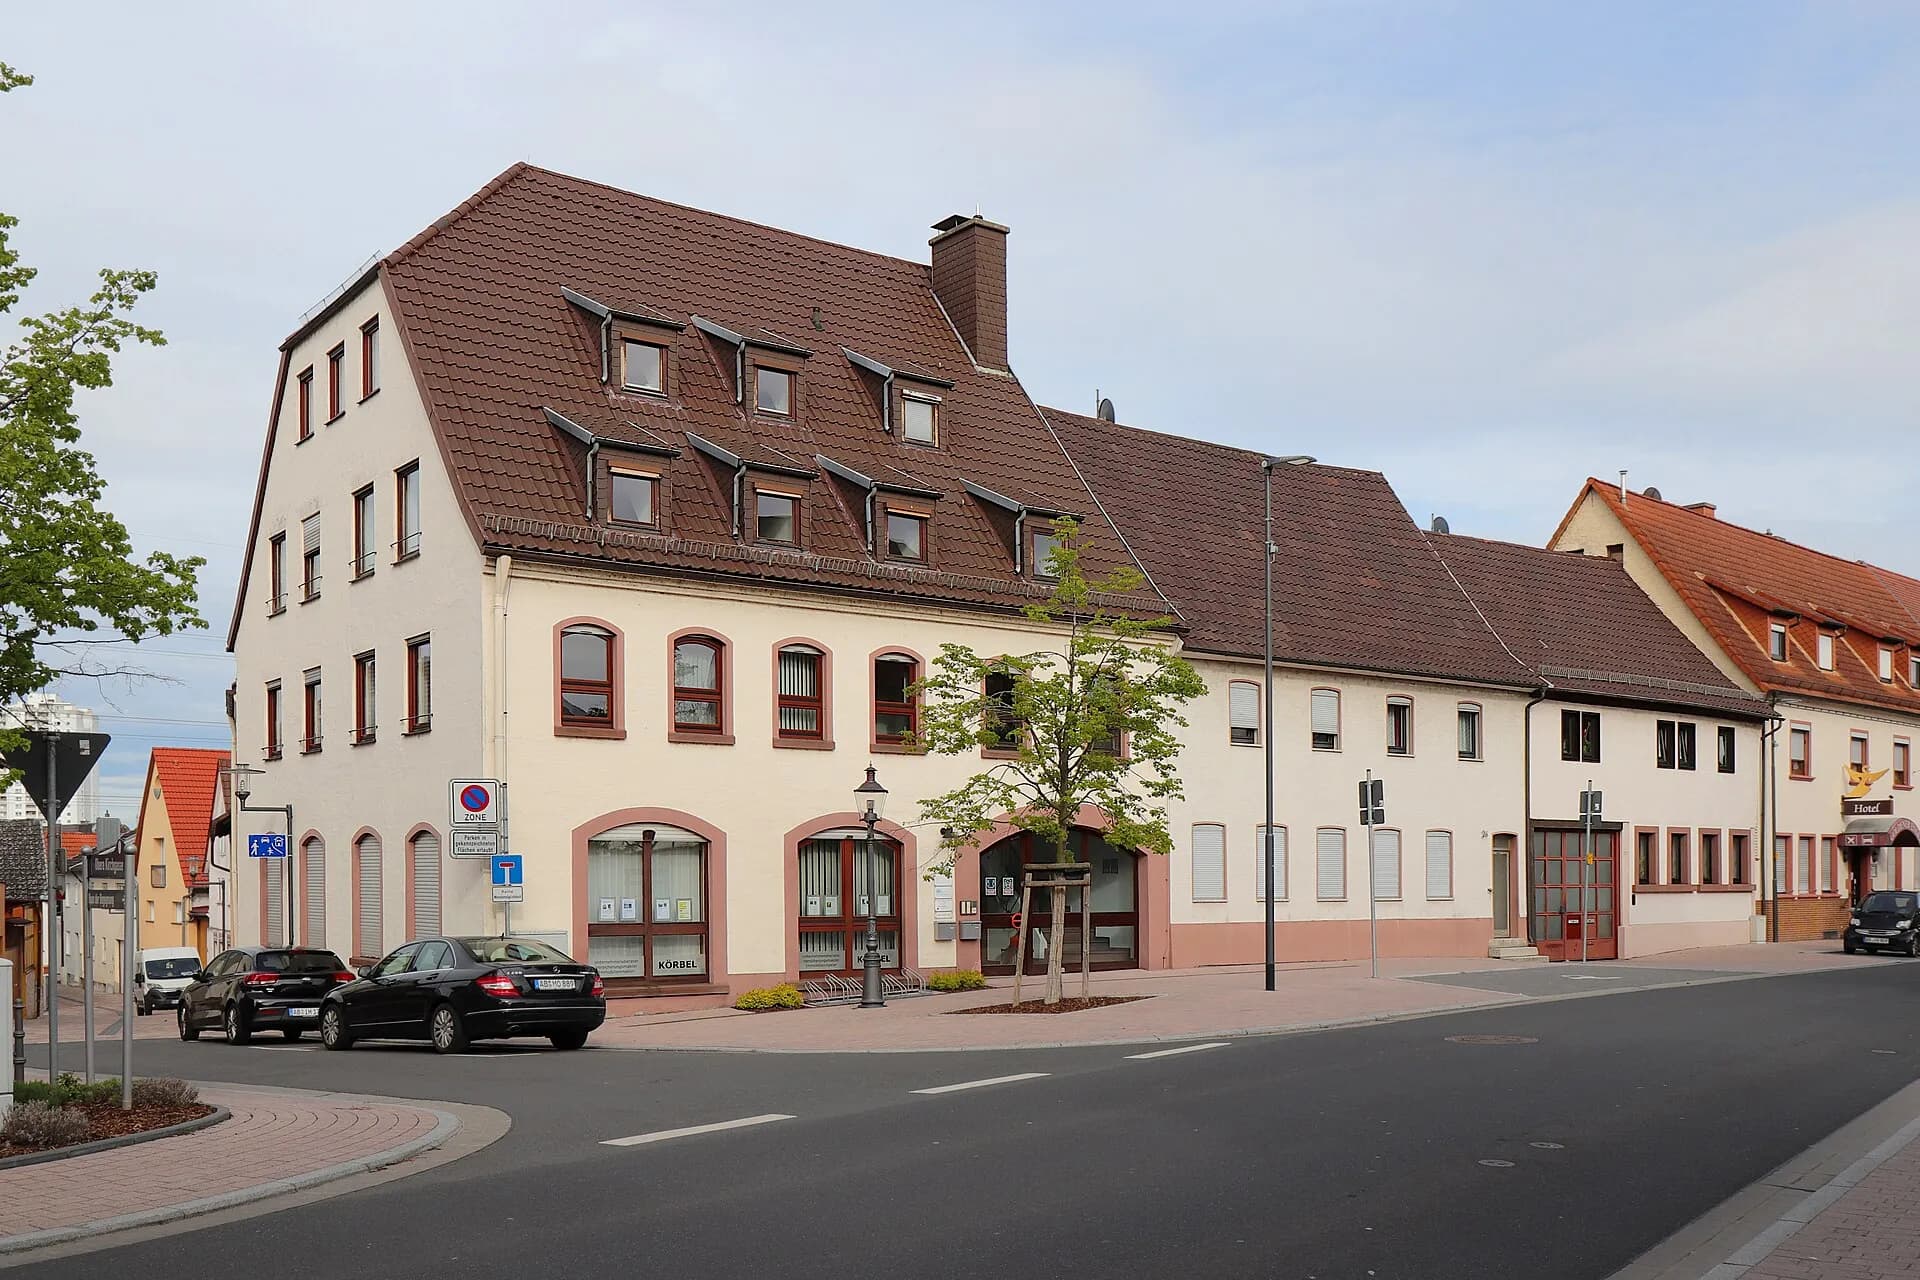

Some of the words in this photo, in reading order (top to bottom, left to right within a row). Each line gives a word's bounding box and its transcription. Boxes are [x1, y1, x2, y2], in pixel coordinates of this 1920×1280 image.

[1854, 802, 1881, 813] Hotel
[464, 813, 487, 821] ZONE
[658, 960, 697, 969] KÖRBEL
